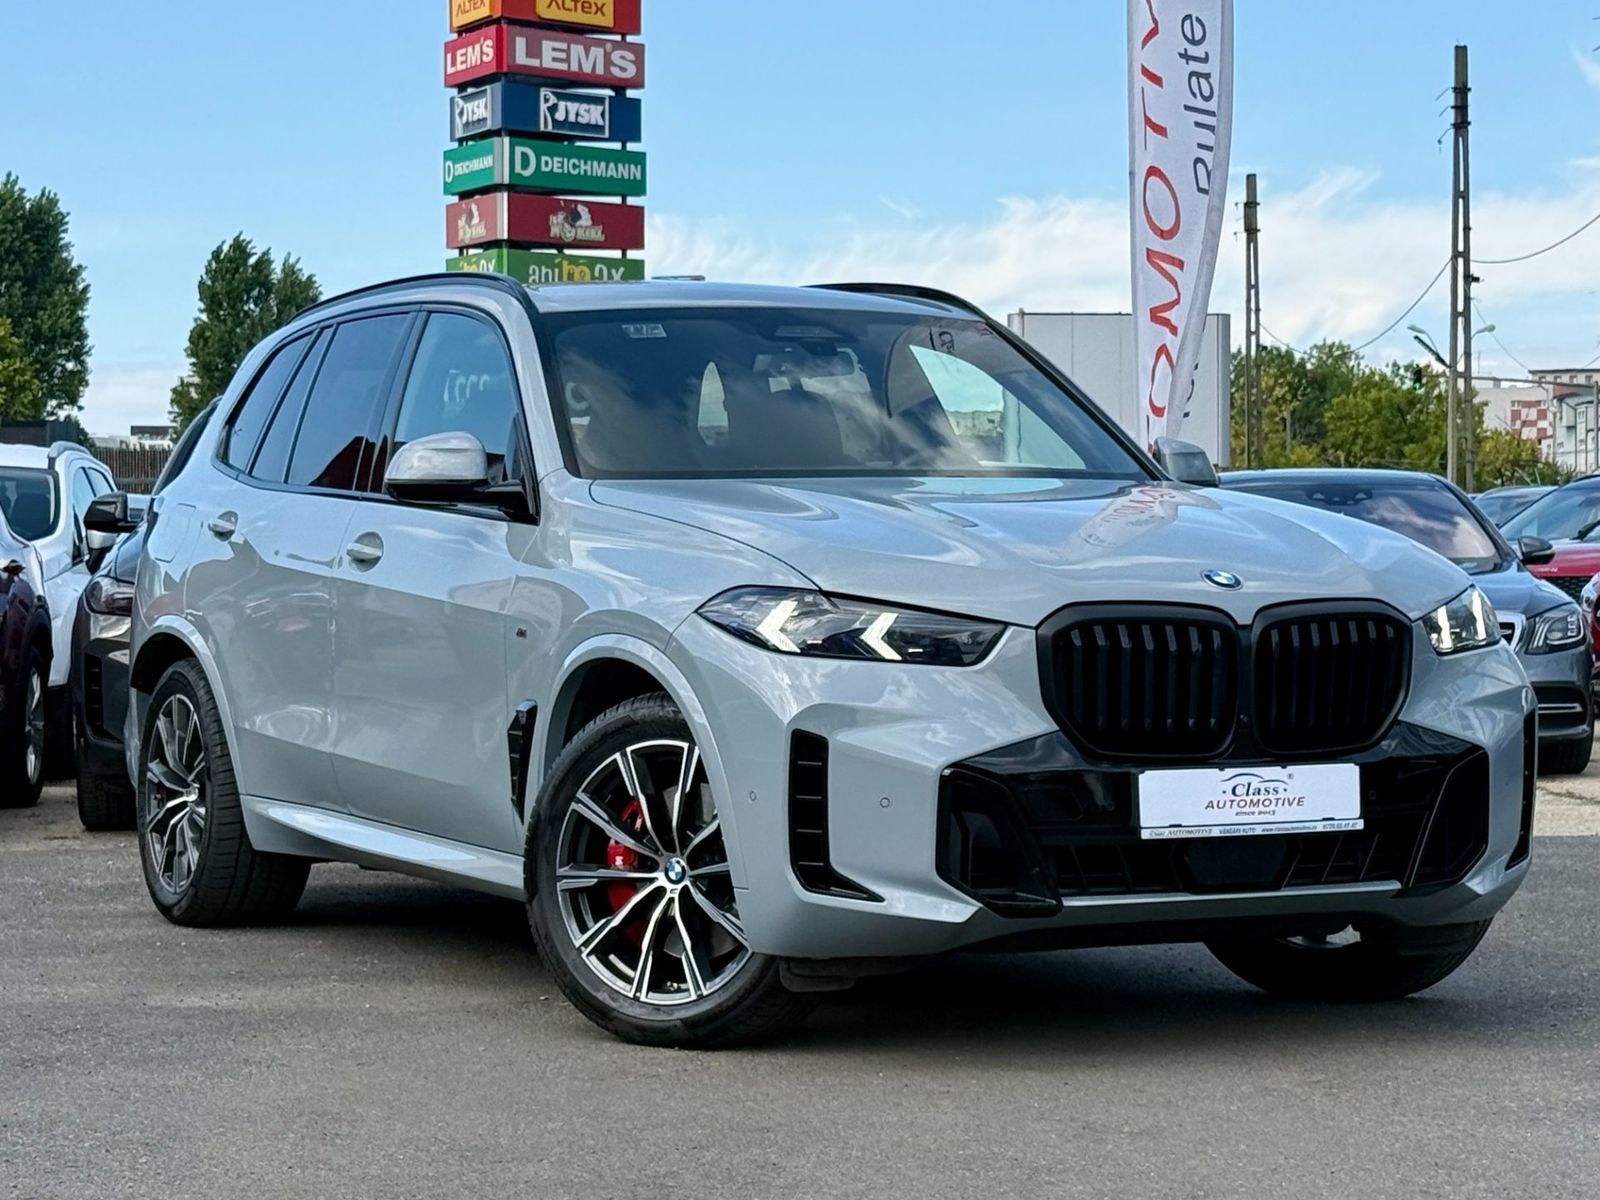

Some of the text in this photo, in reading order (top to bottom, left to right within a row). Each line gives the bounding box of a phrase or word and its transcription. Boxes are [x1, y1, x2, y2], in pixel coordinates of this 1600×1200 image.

[446, 37, 494, 75] LEM'S
[515, 36, 637, 79] LEM'S
[462, 97, 488, 124] JYSK
[554, 100, 605, 127] JYSK
[454, 154, 494, 176] DEICHMANN
[514, 145, 642, 180] D DEICHMANN
[1205, 796, 1306, 810] AUTOMOTIVE
[1231, 782, 1279, 797] Class
